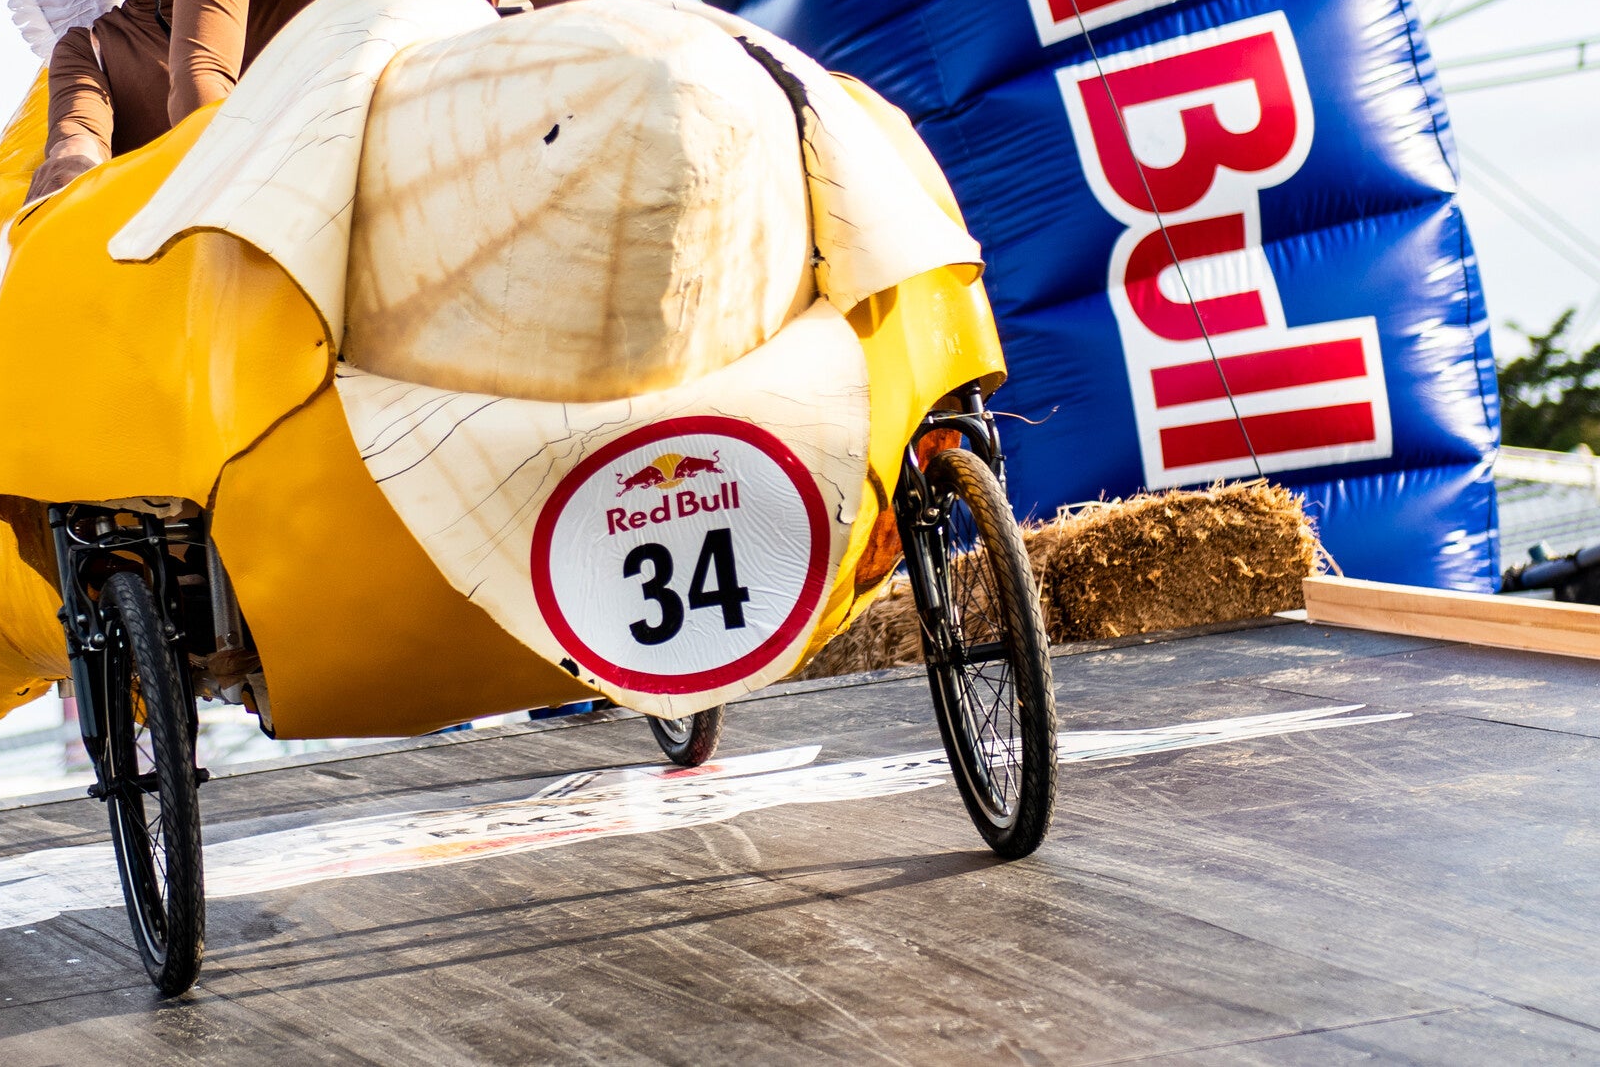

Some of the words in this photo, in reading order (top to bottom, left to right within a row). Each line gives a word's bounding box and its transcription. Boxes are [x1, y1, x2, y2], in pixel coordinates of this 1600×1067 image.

[1075, 29, 1376, 470] Bull
[605, 495, 671, 535] Red
[676, 481, 741, 518] Bull
[622, 527, 751, 646] 34
